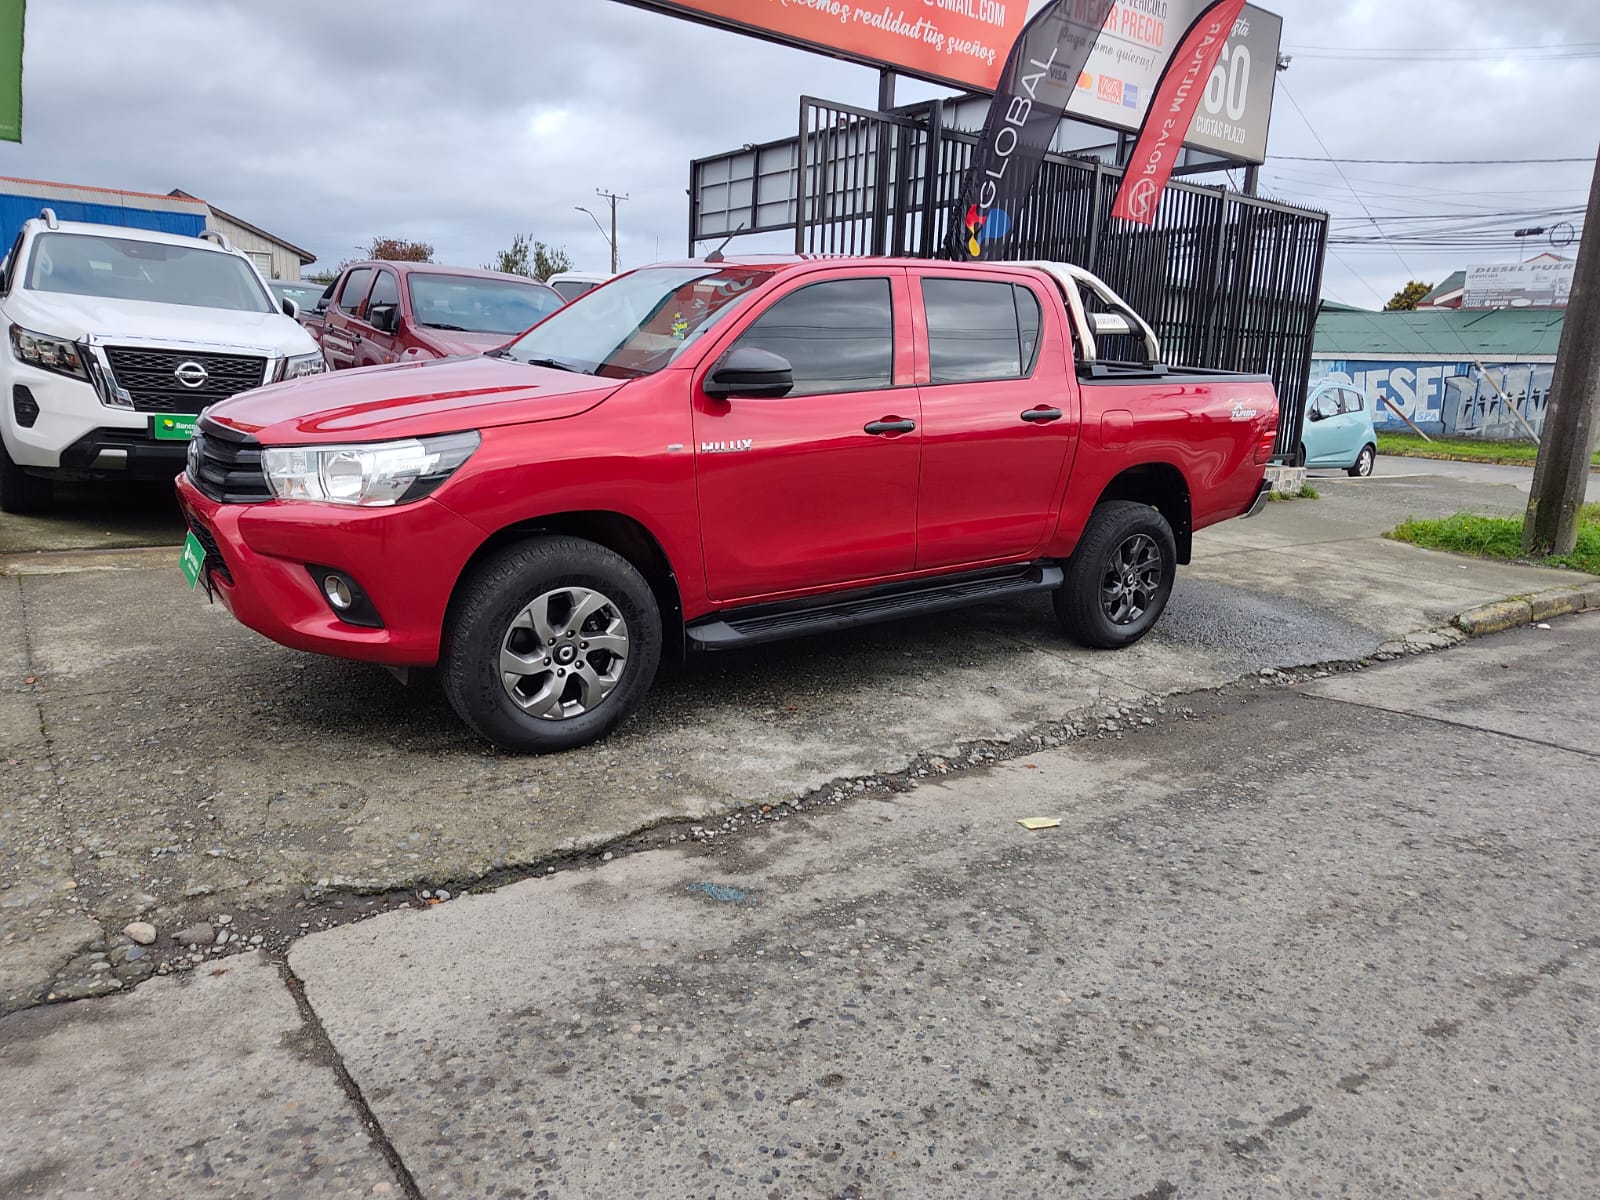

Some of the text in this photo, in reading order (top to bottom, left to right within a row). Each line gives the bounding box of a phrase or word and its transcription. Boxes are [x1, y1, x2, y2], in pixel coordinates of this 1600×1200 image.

[923, 0, 1006, 28] MAIL.COM
[1120, 9, 1164, 47] PRECIO
[1231, 18, 1250, 37] sta
[782, 0, 996, 66] emos realidad tus sueños
[1050, 68, 1068, 82] VISA
[1204, 41, 1251, 120] 60
[979, 48, 1057, 208] GLOBAL
[1196, 116, 1245, 144] CUOTAS PLAZO
[1475, 265, 1525, 273] DIESEL
[1232, 409, 1257, 418] TURBO
[701, 439, 752, 452] HILUX
